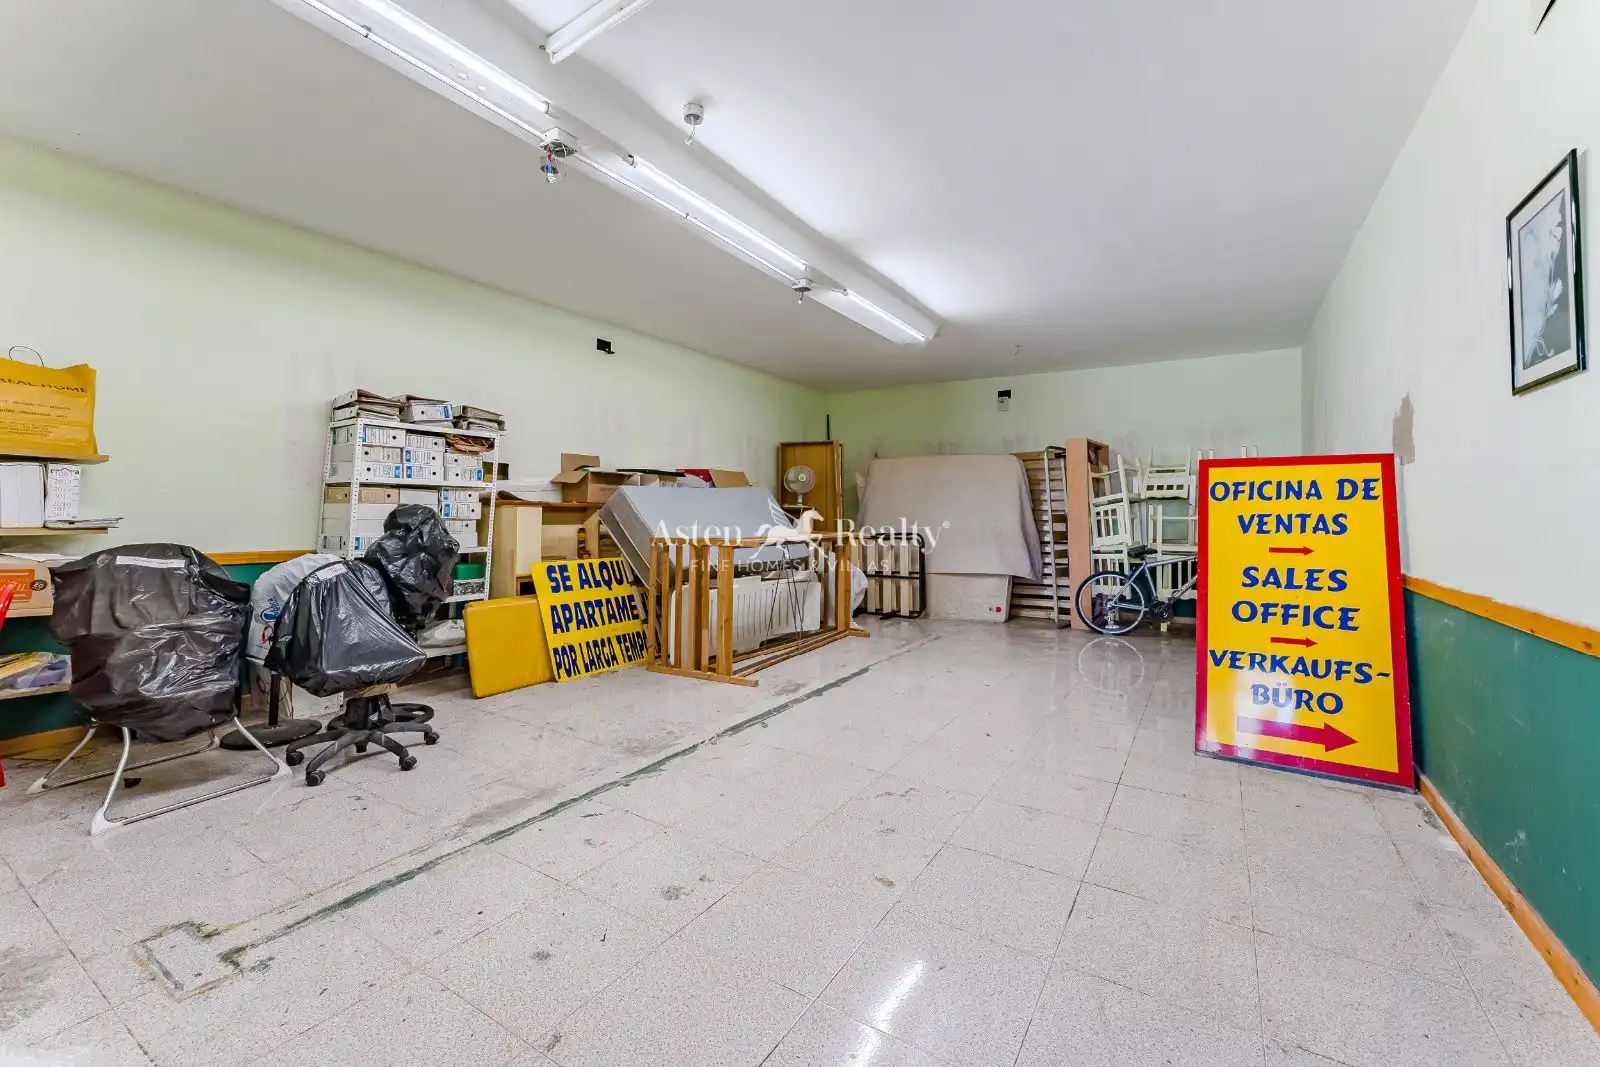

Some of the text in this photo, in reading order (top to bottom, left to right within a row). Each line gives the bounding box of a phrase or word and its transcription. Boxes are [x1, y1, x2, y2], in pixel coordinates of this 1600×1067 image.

[1209, 477, 1381, 502] OFICINA DE
[1237, 512, 1349, 536] VENTAS
[546, 564, 574, 594] SE
[1241, 565, 1349, 593] SALES
[1231, 600, 1361, 632] OFFICE
[552, 644, 581, 680] POR
[1209, 649, 1391, 684] VERKAUFS-
[1251, 681, 1344, 715] BÜRO
